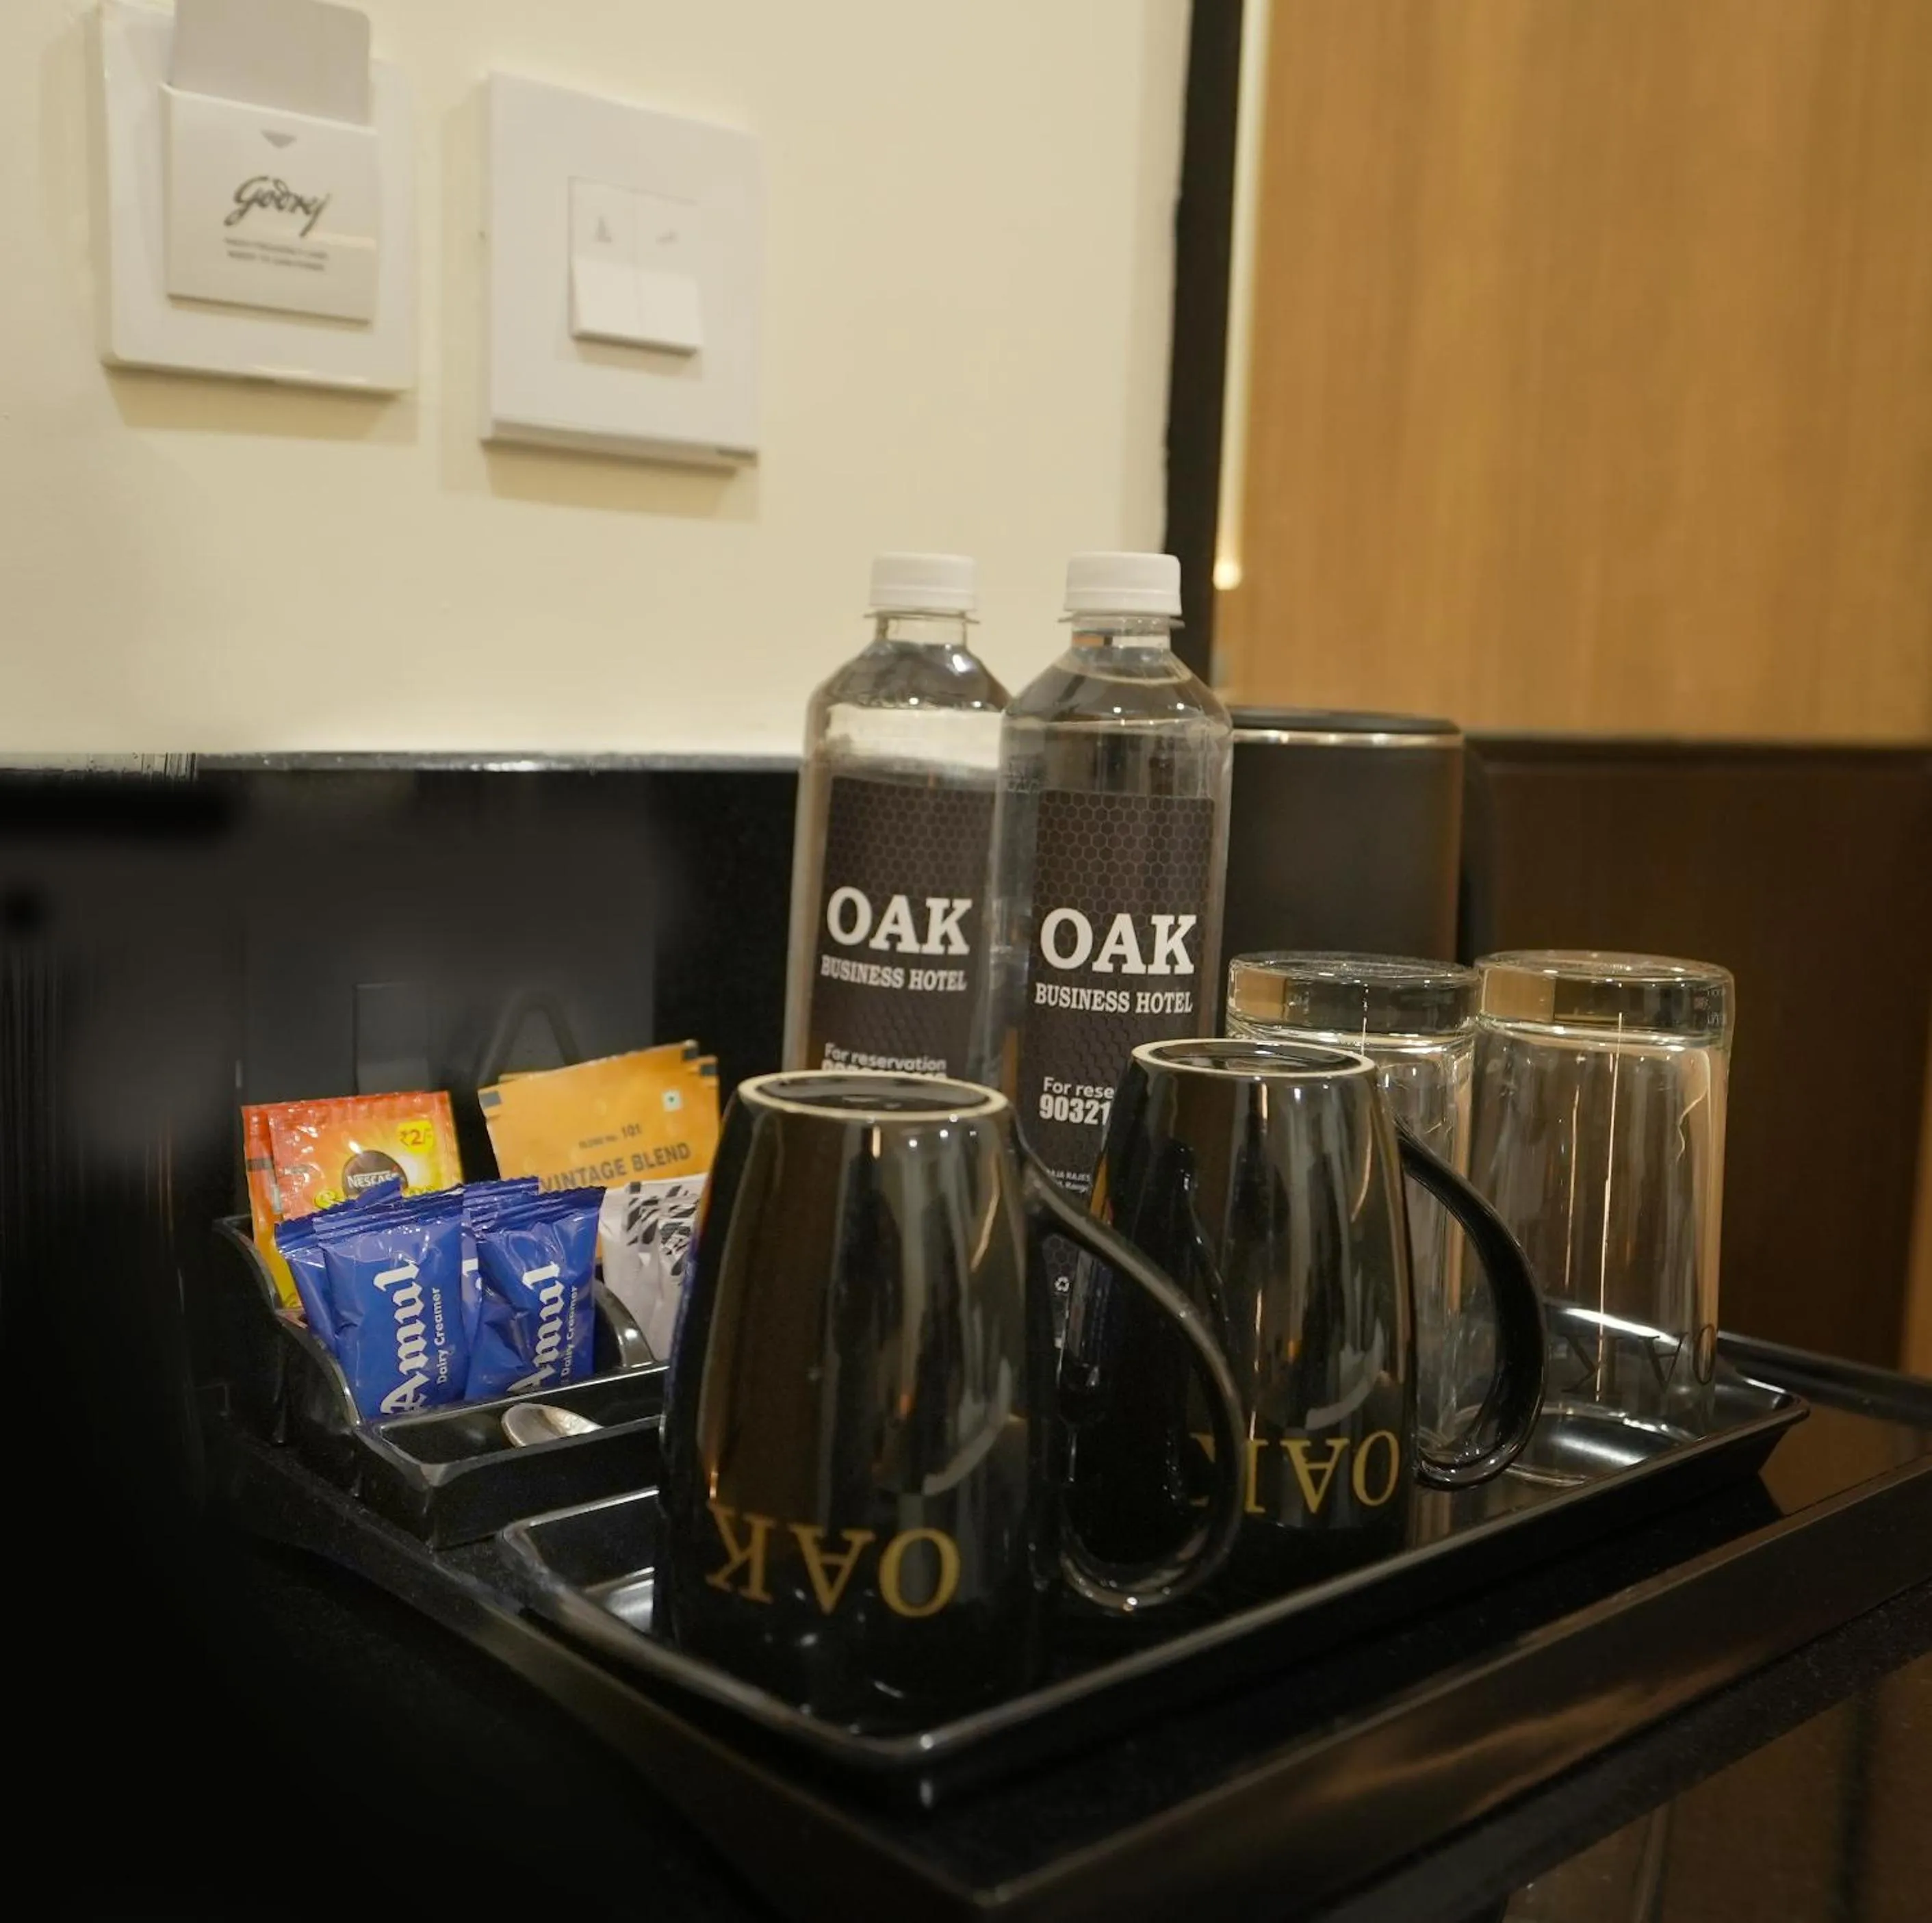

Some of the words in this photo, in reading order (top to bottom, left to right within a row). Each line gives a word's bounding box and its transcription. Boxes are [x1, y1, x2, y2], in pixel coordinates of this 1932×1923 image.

[827, 886, 973, 955] OAK
[1040, 907, 1196, 975] OAK
[821, 954, 905, 989] BUSINESS
[908, 968, 968, 991] HOTEL
[1034, 982, 1131, 1013] BUSINESS
[1135, 992, 1194, 1014] HOTEL
[825, 1042, 849, 1061] For
[851, 1052, 947, 1072] reservation
[1043, 1076, 1072, 1094] For
[347, 1166, 400, 1189] NESCAF
[540, 1157, 627, 1191] VINTAGE
[631, 1142, 691, 1172] BLEND
[432, 1287, 445, 1346] Creamer
[567, 1286, 578, 1341] Creamer
[373, 1259, 430, 1414] Amul
[436, 1349, 450, 1384] Dairy
[561, 1343, 575, 1377] Dairy
[706, 1503, 961, 1618] OAK
